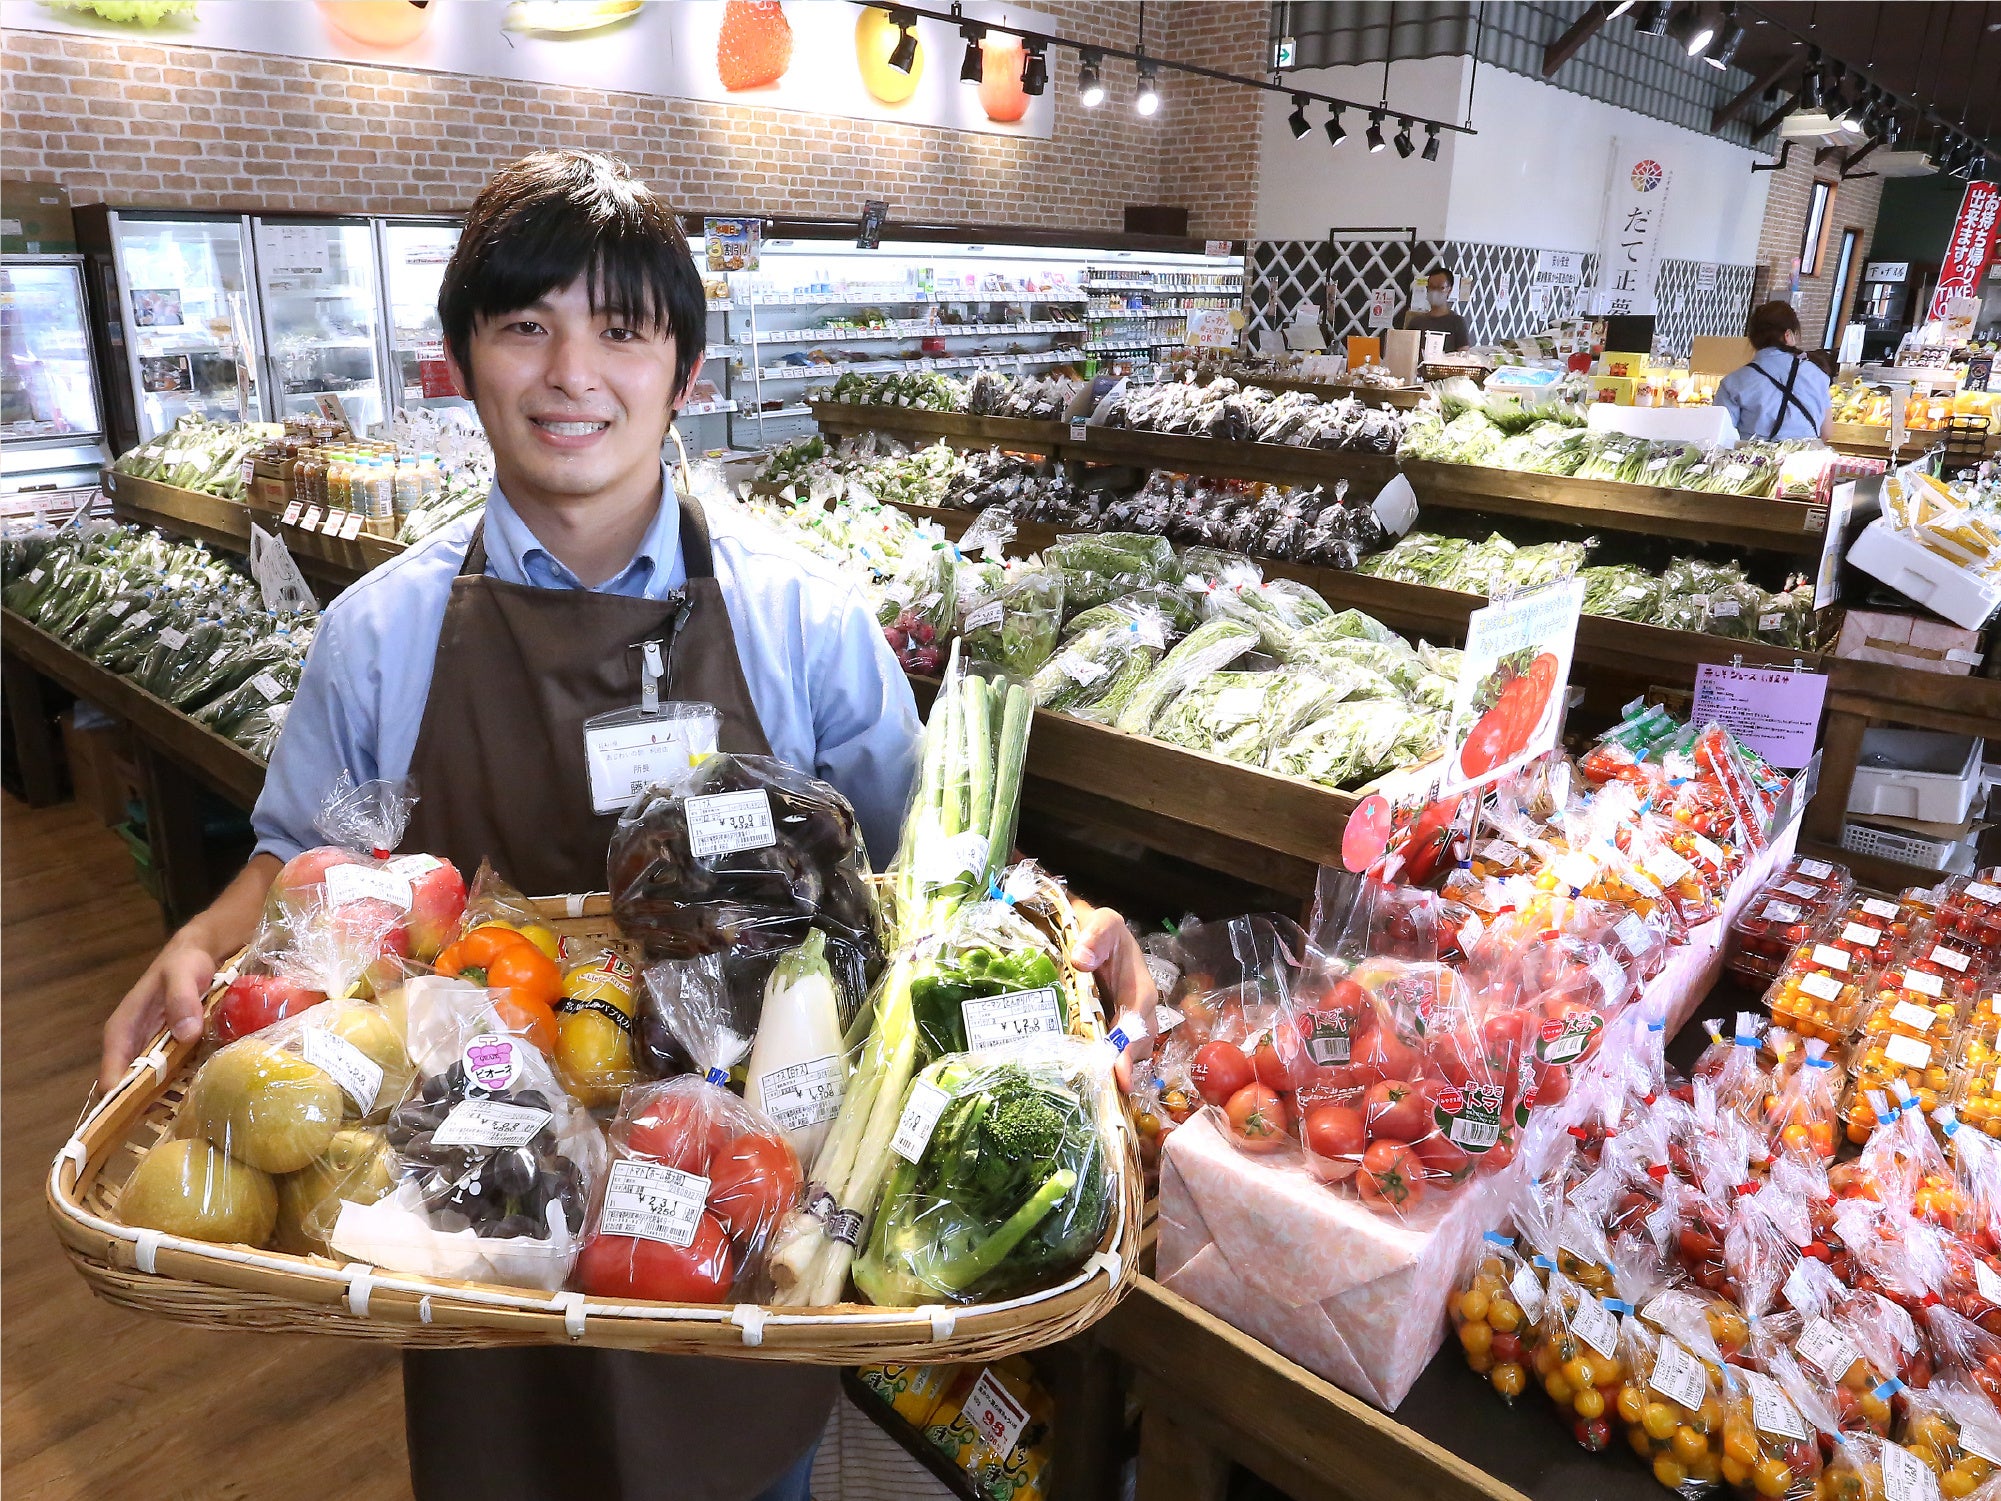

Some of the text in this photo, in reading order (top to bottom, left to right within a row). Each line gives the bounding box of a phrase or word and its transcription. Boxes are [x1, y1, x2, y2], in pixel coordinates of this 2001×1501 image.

[1953, 189, 1987, 273] 出来ます。
[1962, 192, 2001, 284] お持ち帰り
[1607, 207, 1652, 315] だて正夢
[1937, 285, 1973, 300] TAKE
[633, 764, 650, 774] 所長
[719, 813, 753, 826] ¥300
[651, 1205, 676, 1217] ¥250
[983, 1409, 1006, 1438] 98
